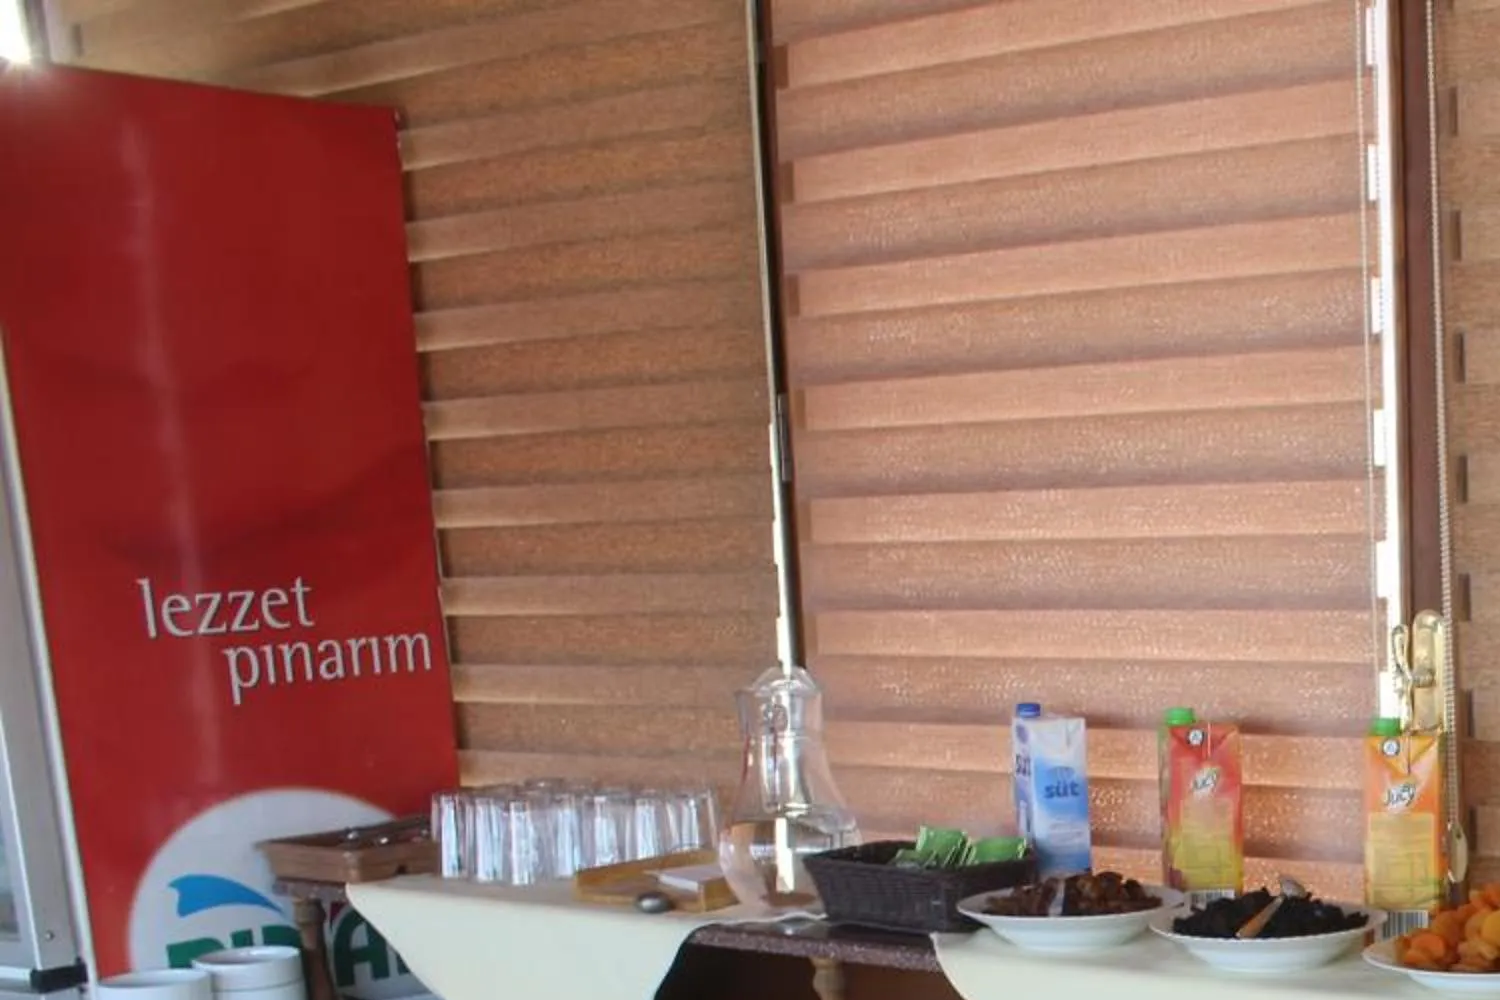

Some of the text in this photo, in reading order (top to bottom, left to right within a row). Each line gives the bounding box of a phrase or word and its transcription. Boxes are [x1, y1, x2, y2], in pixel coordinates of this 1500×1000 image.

[137, 577, 315, 638] lezzet
[222, 630, 432, 704] pınarım
[1043, 779, 1080, 798] süt
[1384, 783, 1416, 807] Jucy
